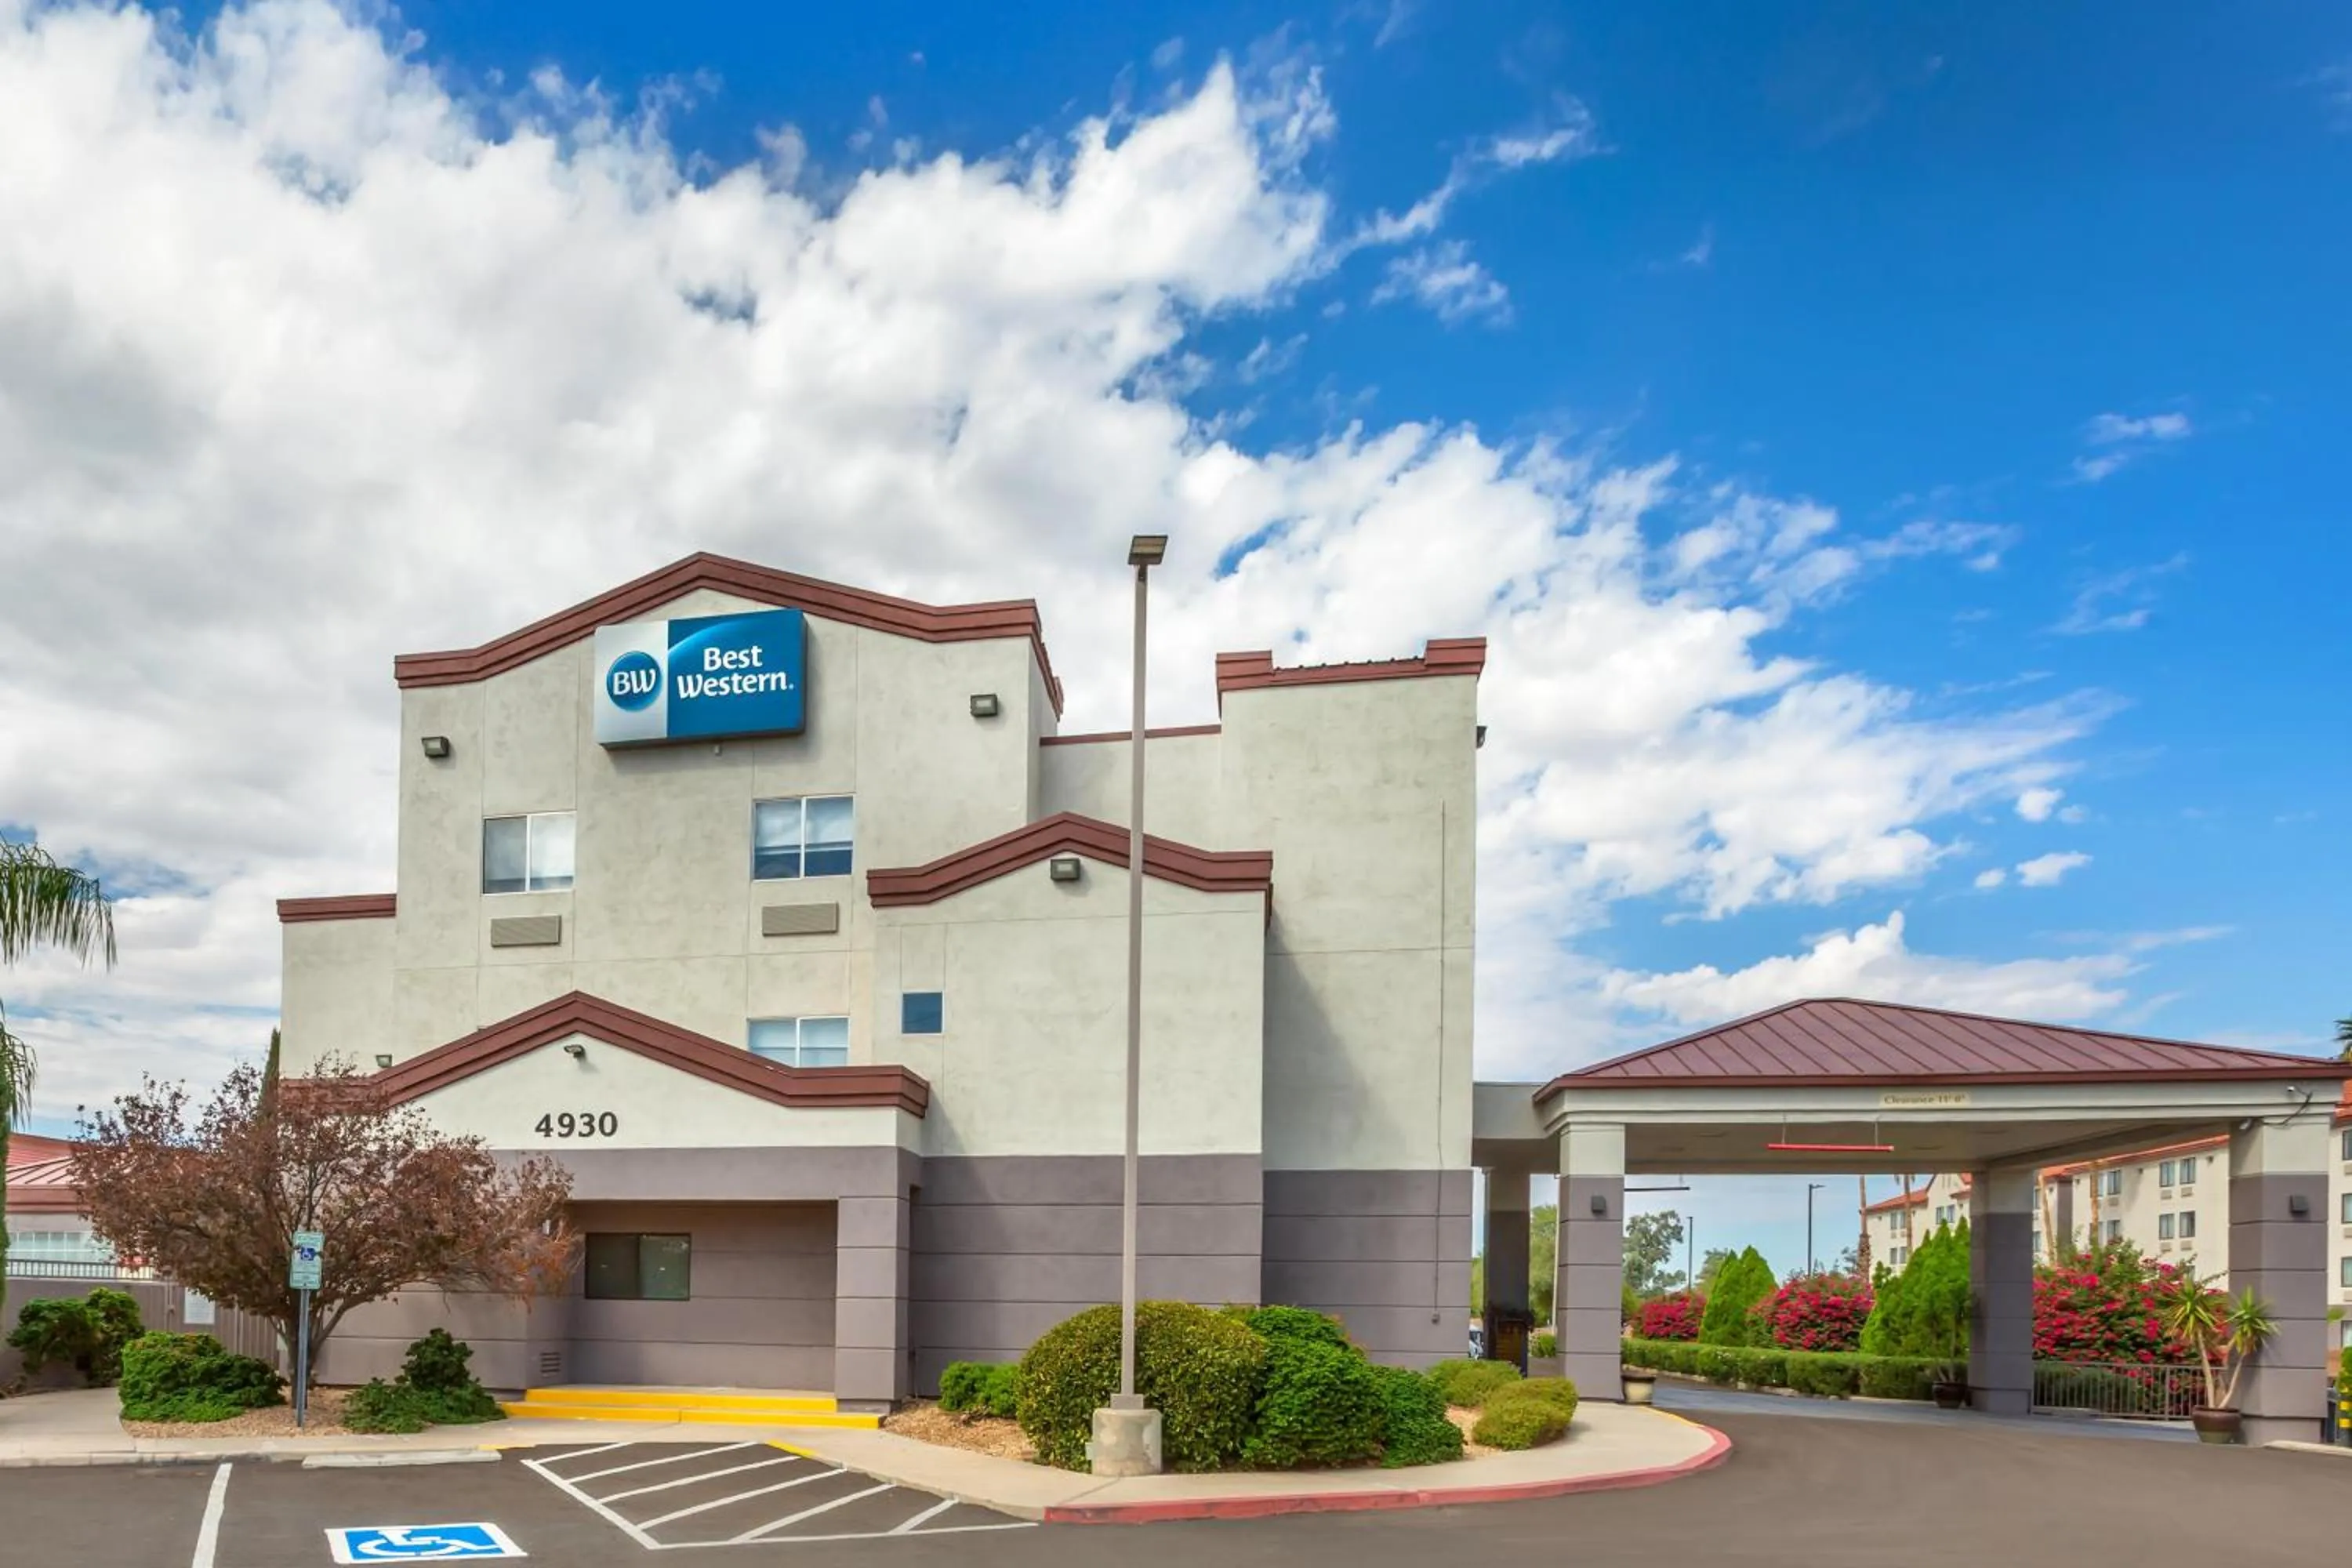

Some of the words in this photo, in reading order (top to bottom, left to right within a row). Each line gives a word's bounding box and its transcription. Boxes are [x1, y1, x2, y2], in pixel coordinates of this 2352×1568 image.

[703, 645, 762, 671] Best
[612, 669, 656, 695] BW
[535, 1111, 618, 1138] 4930
